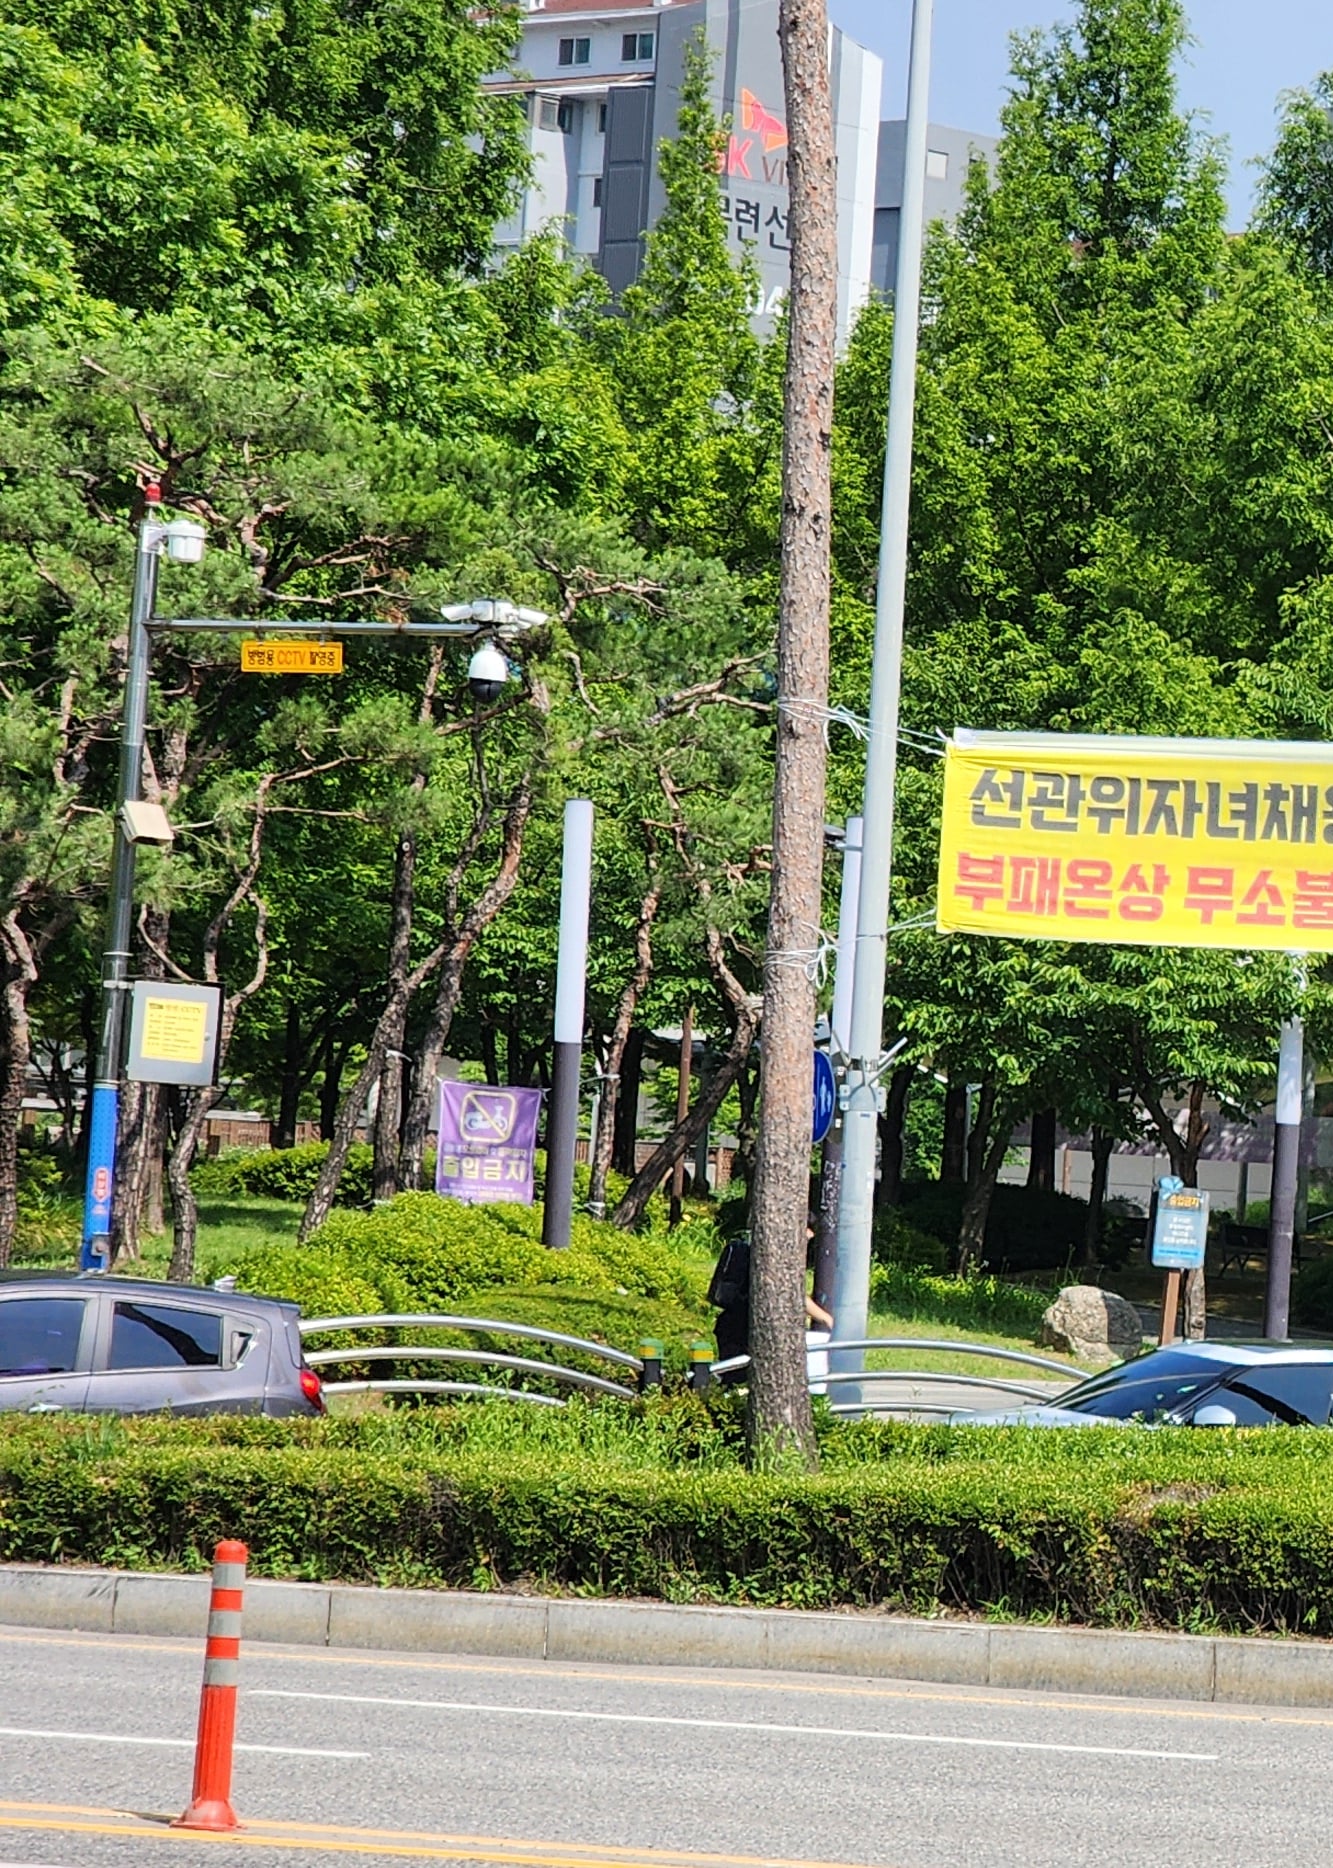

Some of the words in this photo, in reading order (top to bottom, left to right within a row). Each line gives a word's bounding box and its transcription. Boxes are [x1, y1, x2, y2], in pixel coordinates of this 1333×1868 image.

[247, 649, 275, 667] 방범용
[276, 650, 306, 665] CCTV
[955, 852, 1170, 922] 부패온상
[443, 1155, 527, 1183] 출입금지
